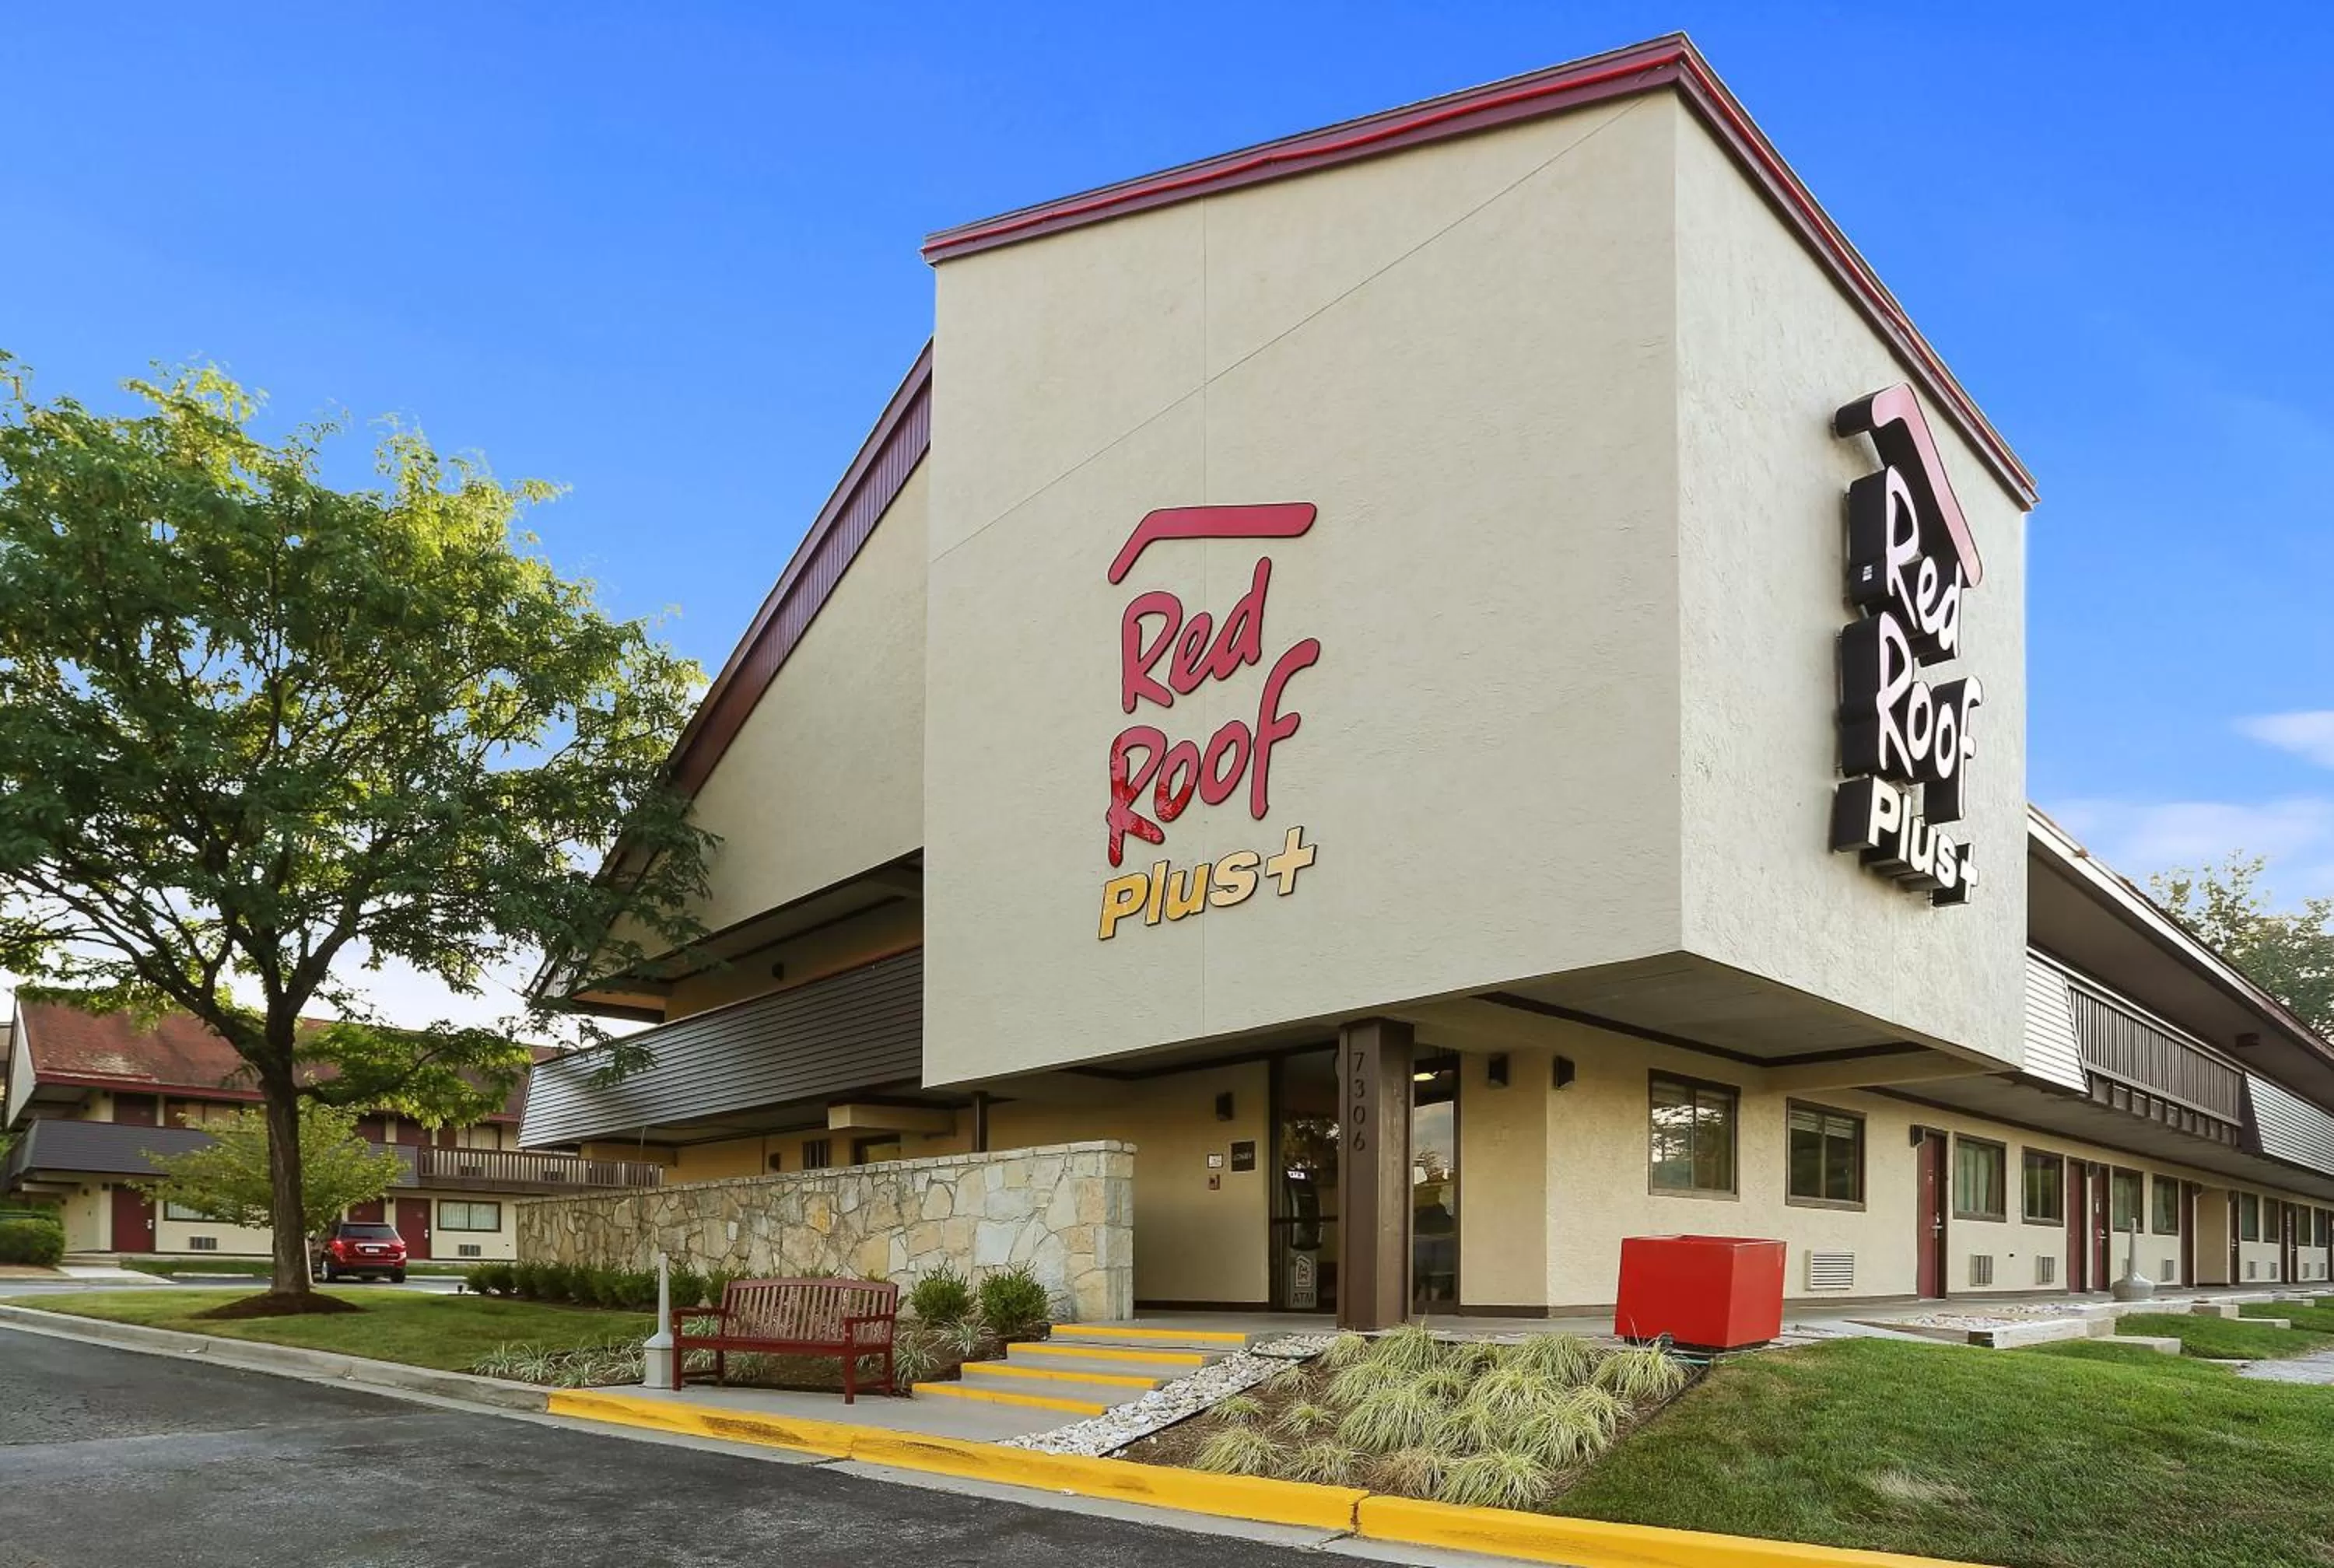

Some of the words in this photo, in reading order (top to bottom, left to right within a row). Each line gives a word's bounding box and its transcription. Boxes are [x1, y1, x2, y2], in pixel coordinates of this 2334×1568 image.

[1122, 556, 1272, 713] Red
[1886, 465, 1962, 660] Red
[1106, 638, 1320, 867] Roof
[1876, 611, 1983, 820] Roof
[1353, 1052, 1365, 1151] 7306
[1293, 1292, 1314, 1305] ATM
